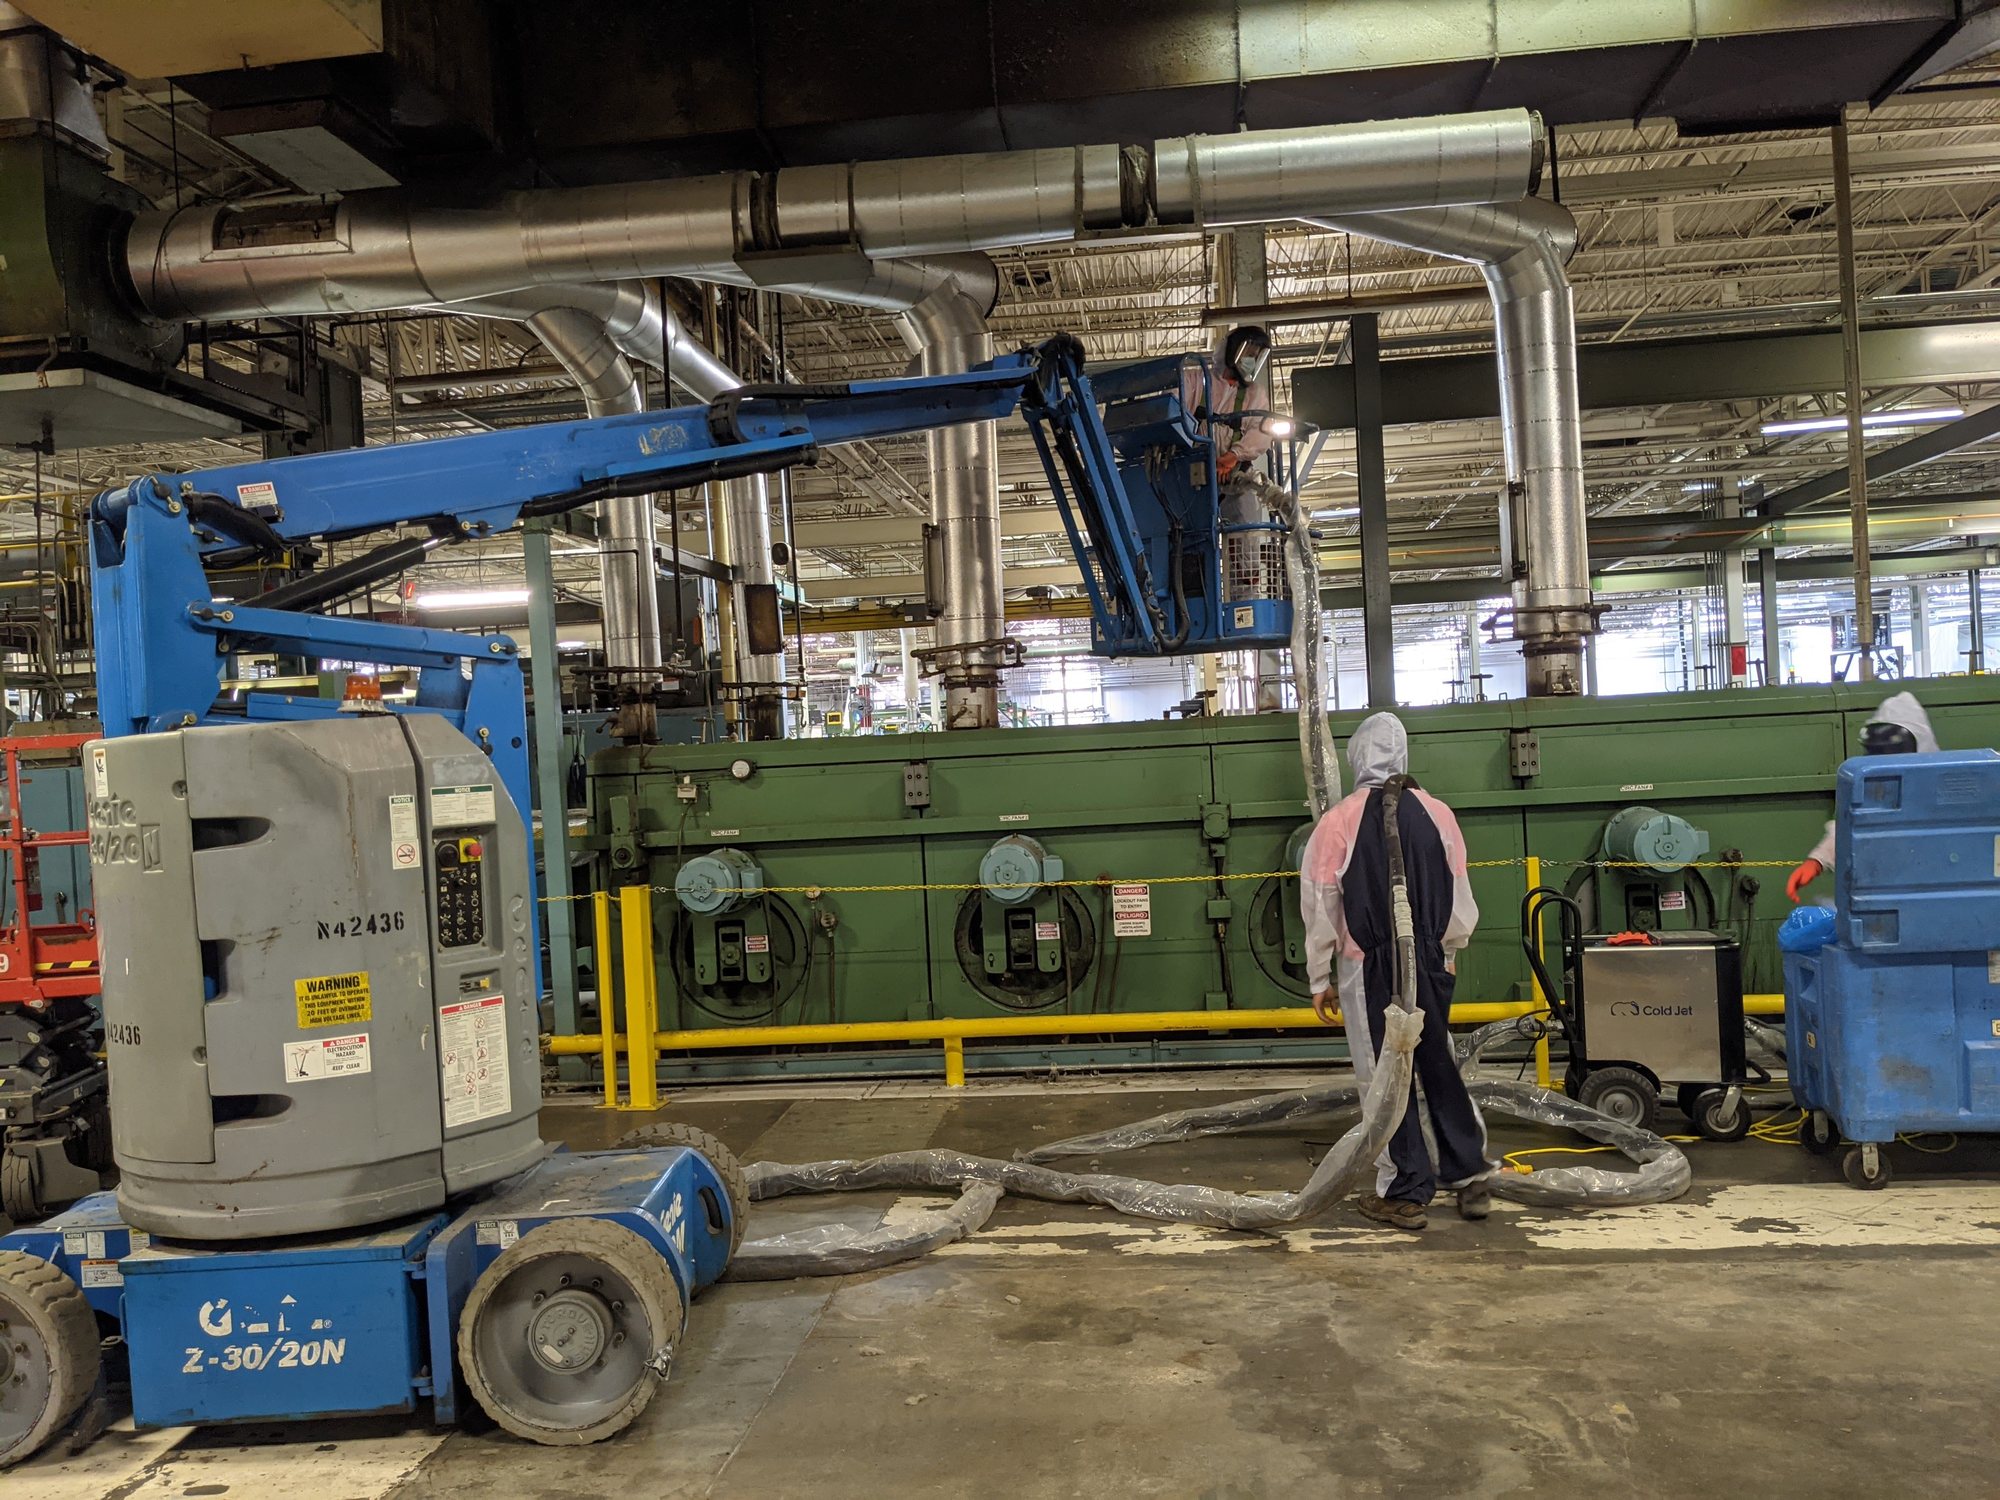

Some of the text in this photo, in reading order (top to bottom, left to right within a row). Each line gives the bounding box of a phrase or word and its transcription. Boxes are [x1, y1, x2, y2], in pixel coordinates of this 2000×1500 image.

[318, 911, 404, 939] N42436
[307, 976, 360, 993] WARNING
[311, 992, 338, 1000] UNLAWFUL
[347, 988, 369, 996] OPERATE
[317, 999, 346, 1007] EQUIPMENT
[464, 1002, 482, 1010] DANGER
[1643, 1005, 1693, 1016] Cold Jet
[336, 1038, 360, 1046] DANGER
[327, 1044, 363, 1053] ELECTROCUTION
[182, 1337, 346, 1373] Z-30/20N
